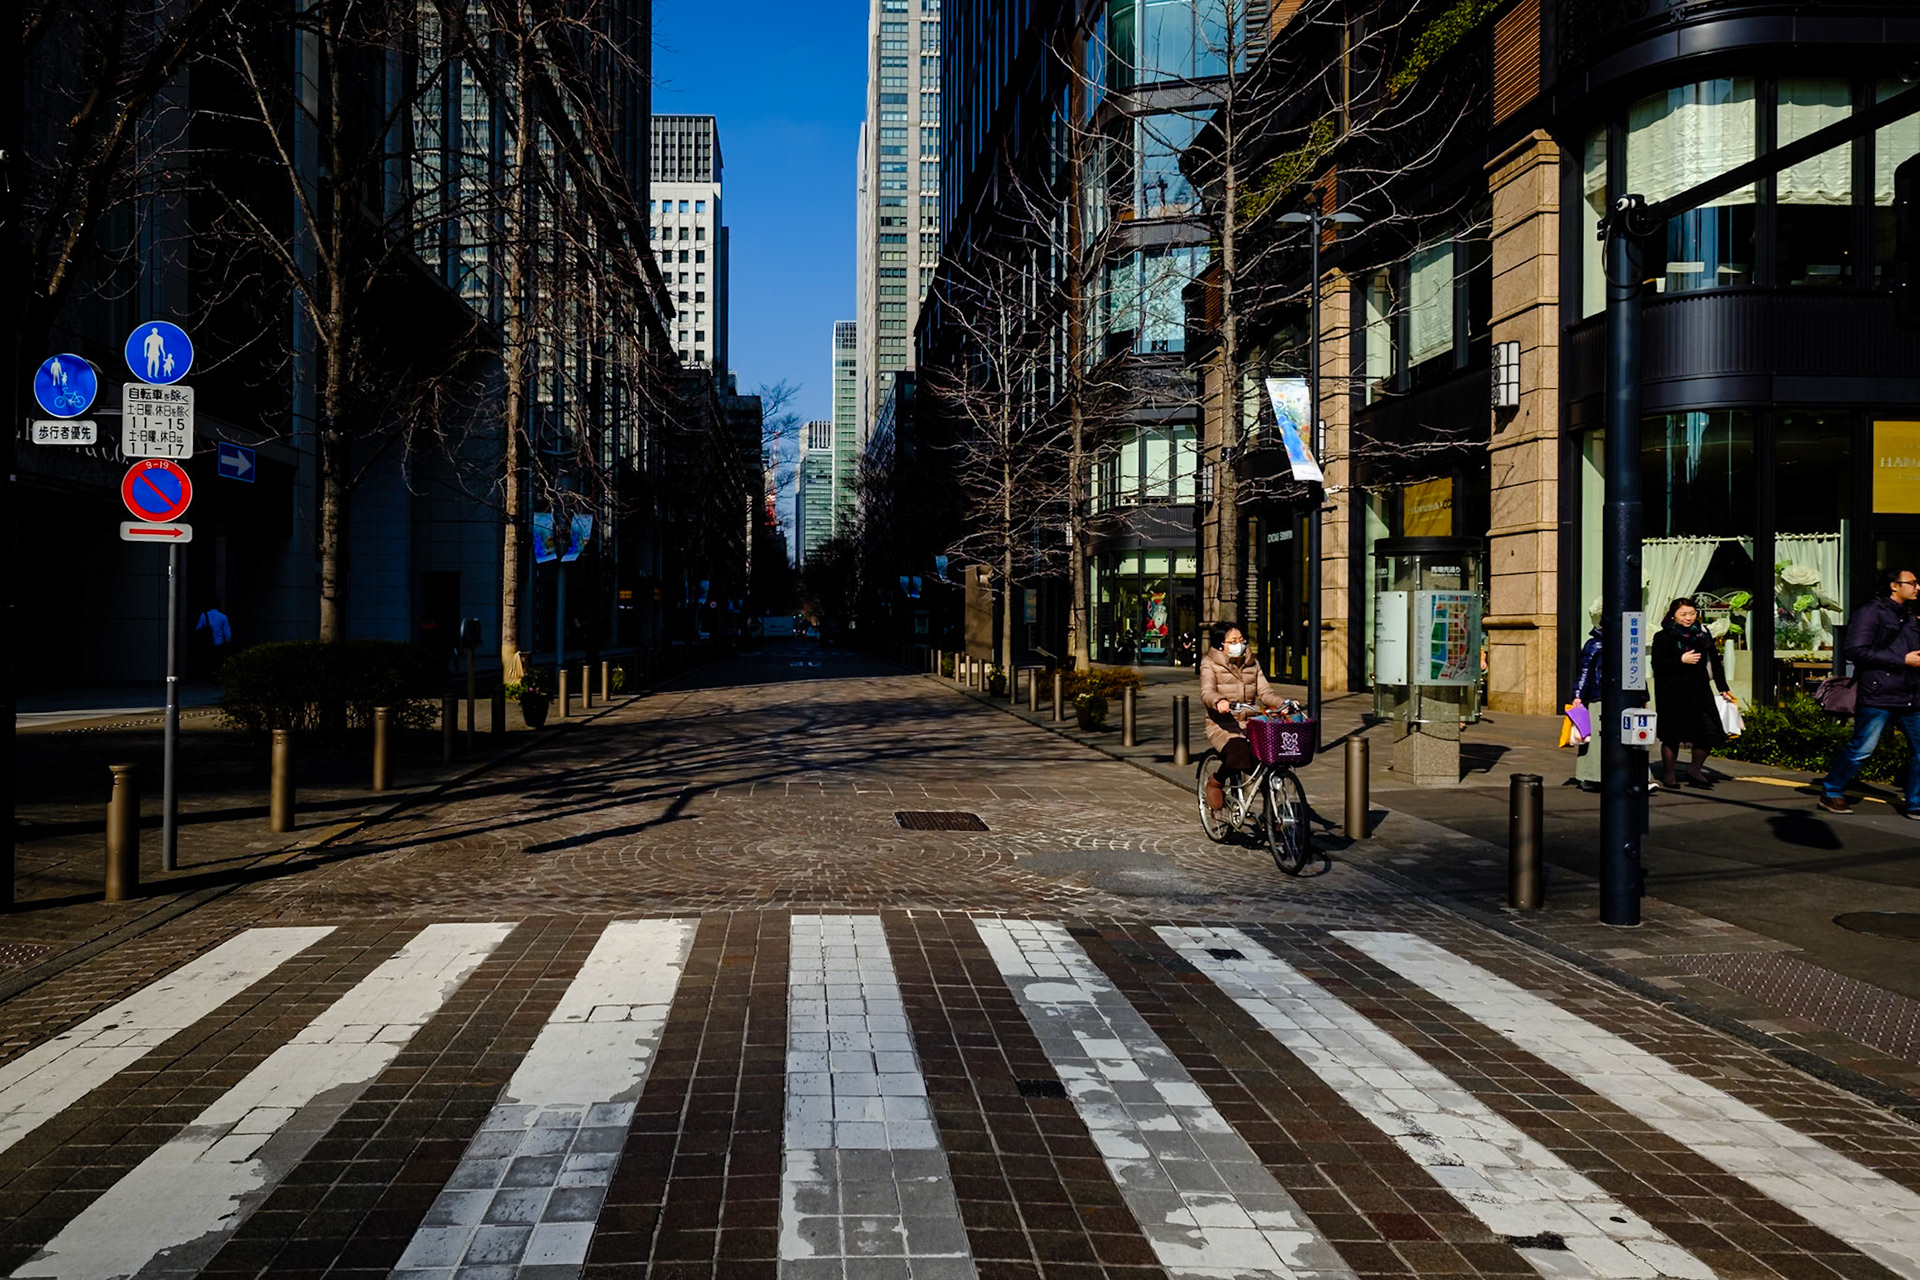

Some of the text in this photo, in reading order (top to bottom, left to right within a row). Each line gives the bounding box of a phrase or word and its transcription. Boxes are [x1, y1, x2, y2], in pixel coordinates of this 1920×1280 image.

[129, 387, 189, 403] 自転車を除く
[132, 416, 185, 431] 11-15
[39, 425, 92, 440] 歩行者優先
[131, 442, 185, 456] 11-17
[145, 461, 169, 470] 9-19
